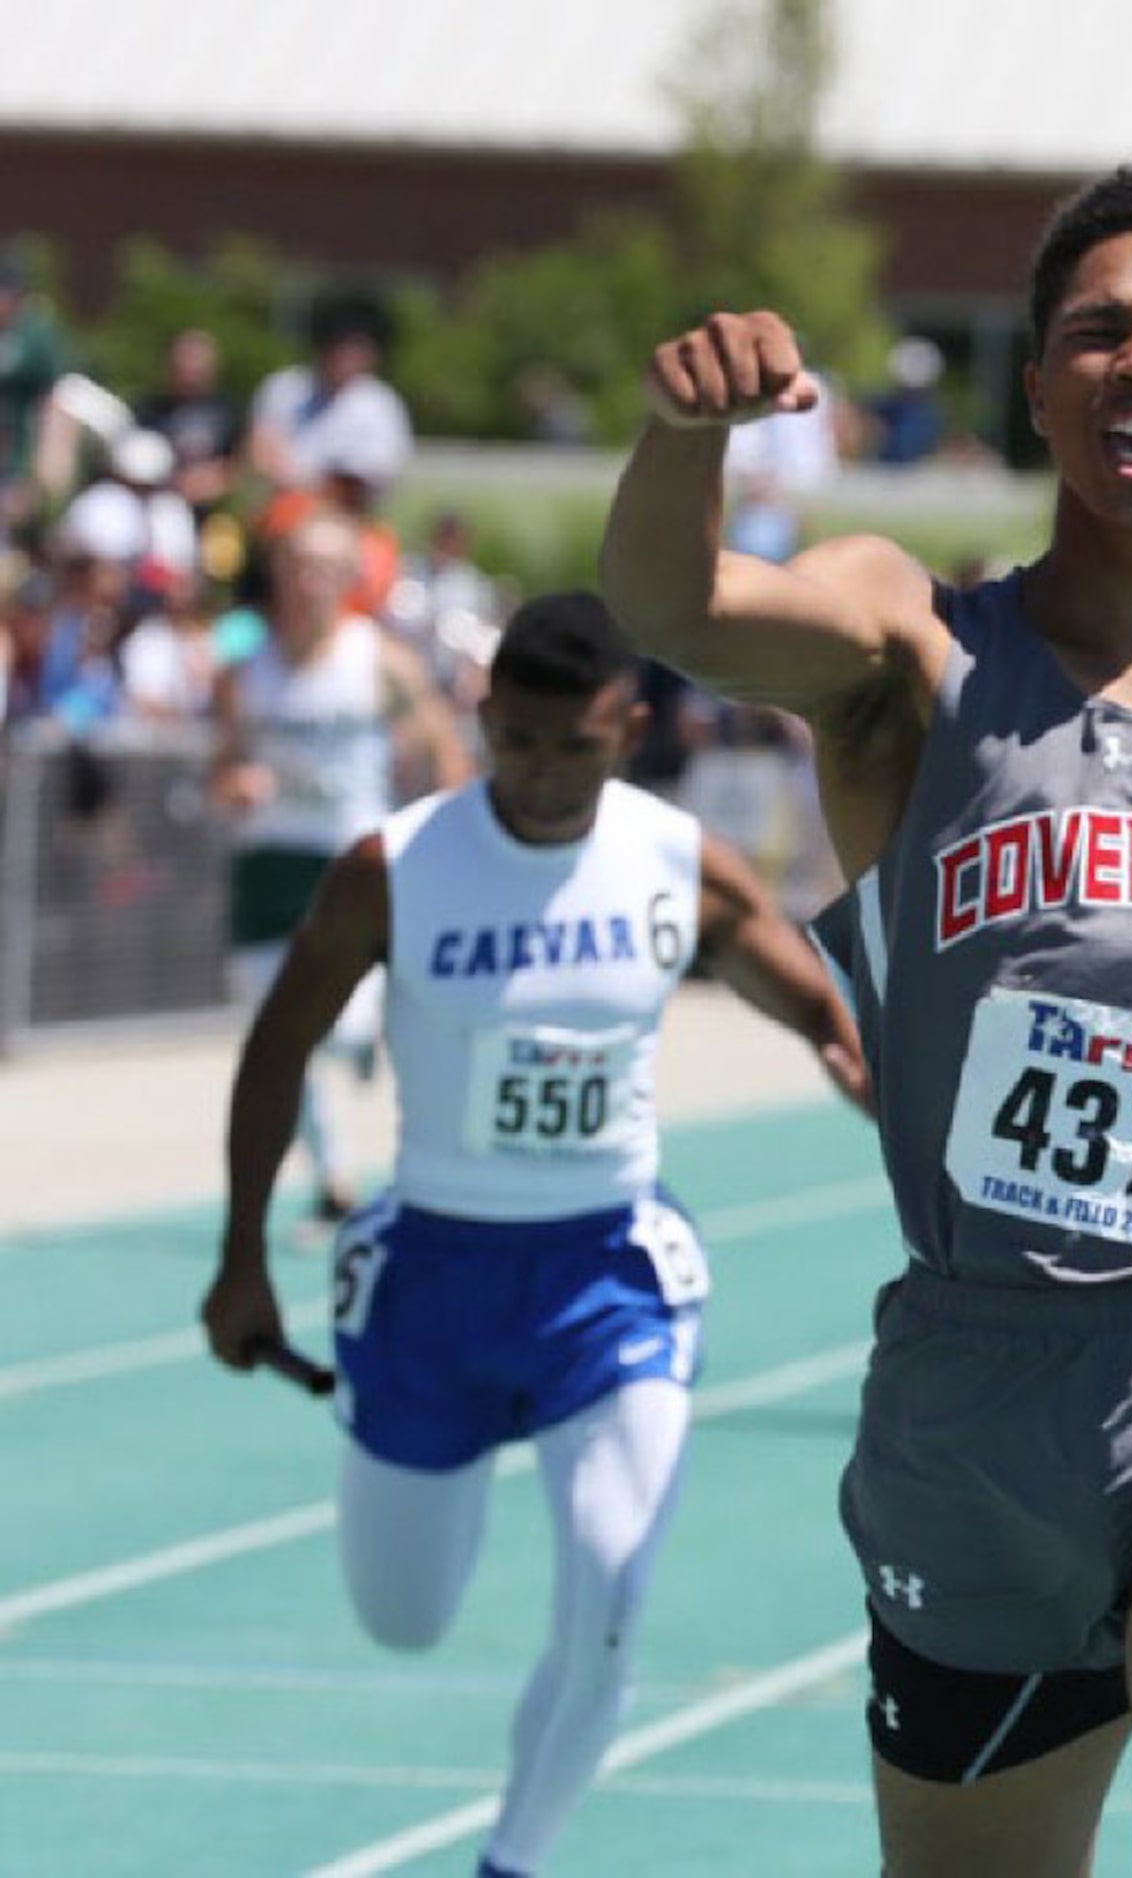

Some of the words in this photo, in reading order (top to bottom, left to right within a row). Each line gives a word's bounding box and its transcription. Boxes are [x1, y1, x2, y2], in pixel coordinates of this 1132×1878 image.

[648, 890, 682, 970] 6
[495, 1074, 608, 1138] 550
[981, 1175, 1043, 1213] TRACK
